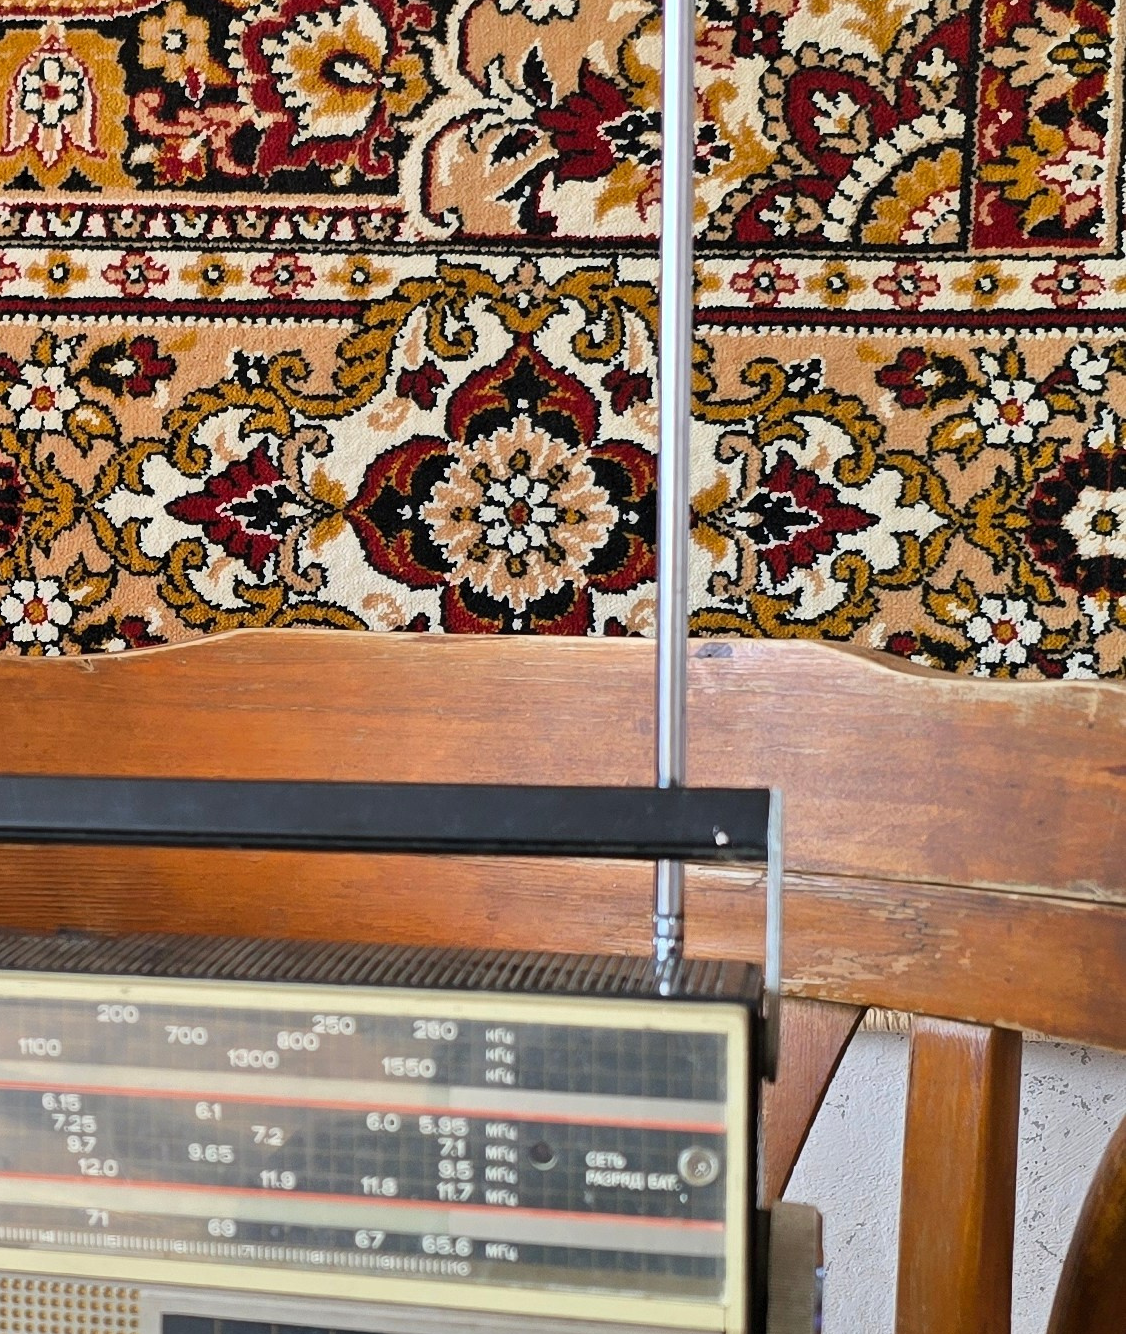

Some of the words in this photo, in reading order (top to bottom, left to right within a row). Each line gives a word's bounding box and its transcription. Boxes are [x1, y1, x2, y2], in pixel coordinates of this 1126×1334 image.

[96, 1004, 139, 1024] 200
[312, 1015, 356, 1035] 250
[165, 1026, 208, 1045] 700
[19, 1037, 62, 1056] 1100
[381, 1056, 436, 1078] 1550
[41, 1093, 82, 1112] 6.15
[195, 1101, 222, 1120] 6.1
[366, 1113, 402, 1133] 6.0
[419, 1116, 469, 1137] 5.95
[52, 1113, 97, 1133] 7.25
[252, 1125, 284, 1147] 7.2
[438, 1138, 467, 1157] 7.1
[67, 1136, 96, 1153] 9.7
[188, 1143, 234, 1164] 9.65
[438, 1160, 471, 1180] 9.5
[585, 1151, 626, 1169] СЕТЬ
[78, 1158, 119, 1177] 12.0
[260, 1169, 296, 1190] 11.9
[361, 1176, 399, 1197] 11.8
[436, 1181, 470, 1203] 11.7
[86, 1209, 109, 1227] 71
[208, 1219, 237, 1238] 69
[354, 1229, 386, 1249] 67
[422, 1234, 473, 1257] 65.6
